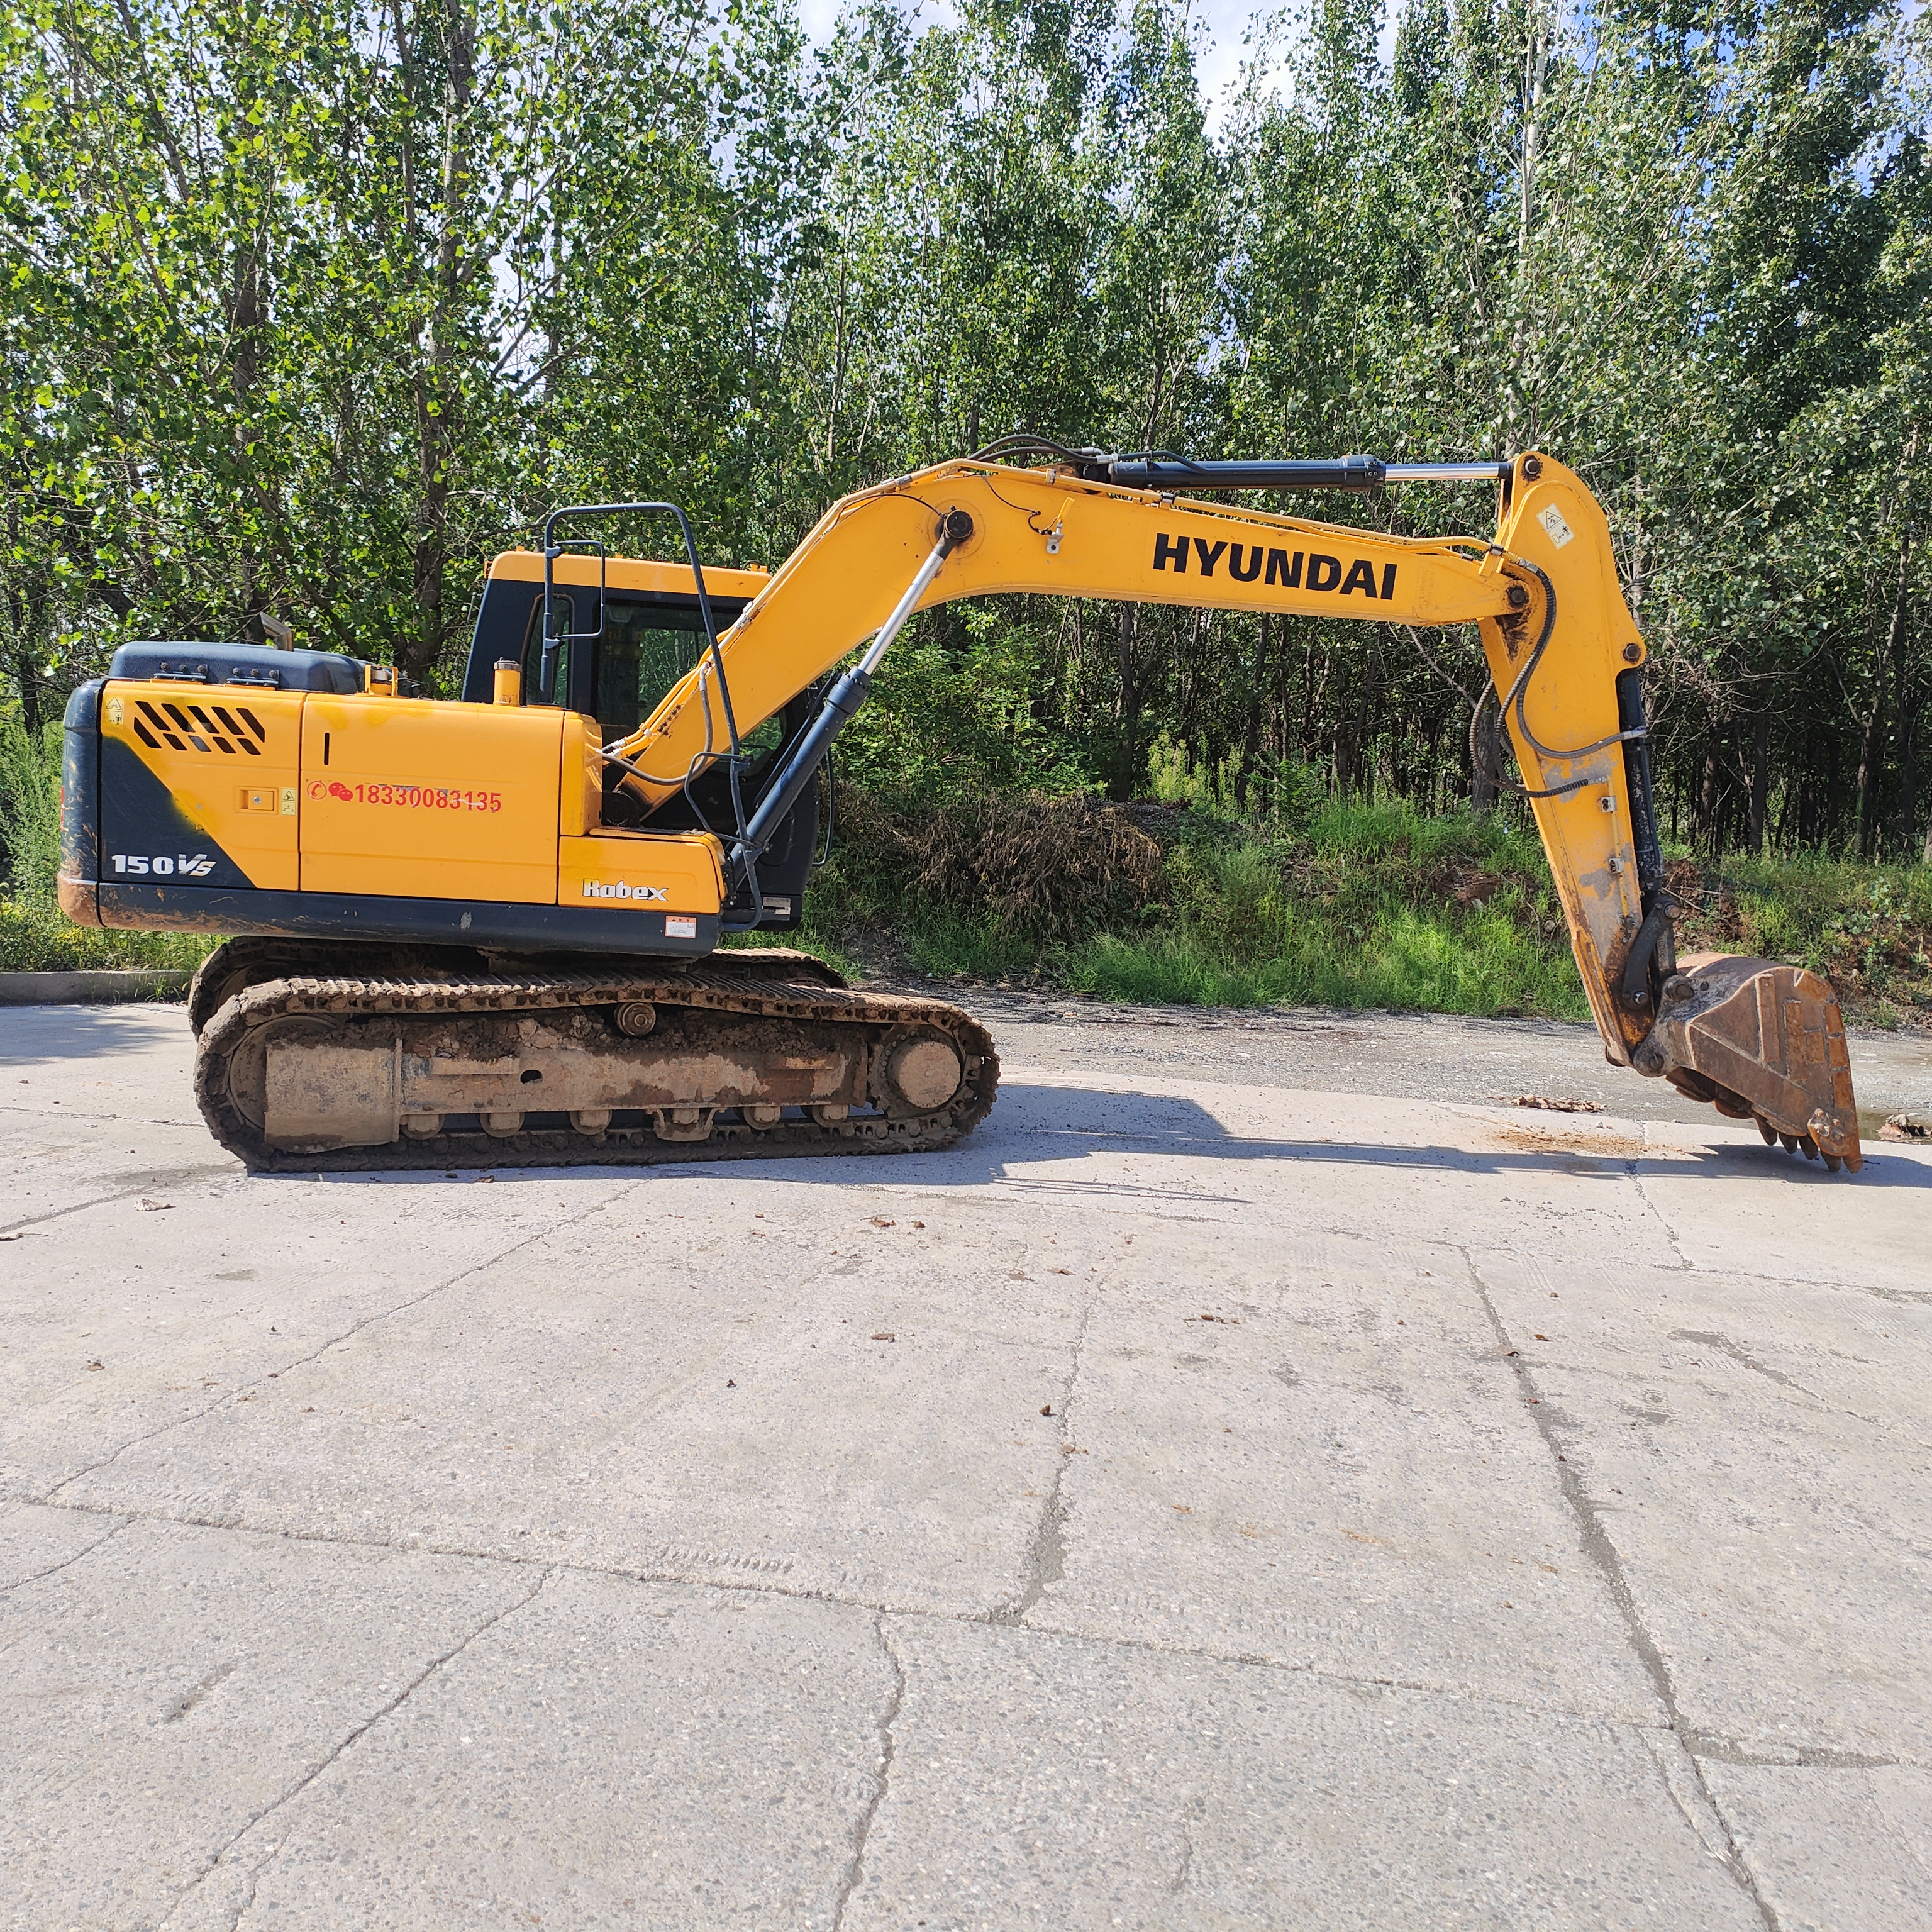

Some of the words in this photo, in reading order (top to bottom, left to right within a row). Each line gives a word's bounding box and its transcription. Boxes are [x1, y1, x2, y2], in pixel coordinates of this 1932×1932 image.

[1152, 533, 1397, 601] HYUNDAI
[355, 784, 502, 813] 18330083135
[582, 879, 669, 901] Robex
